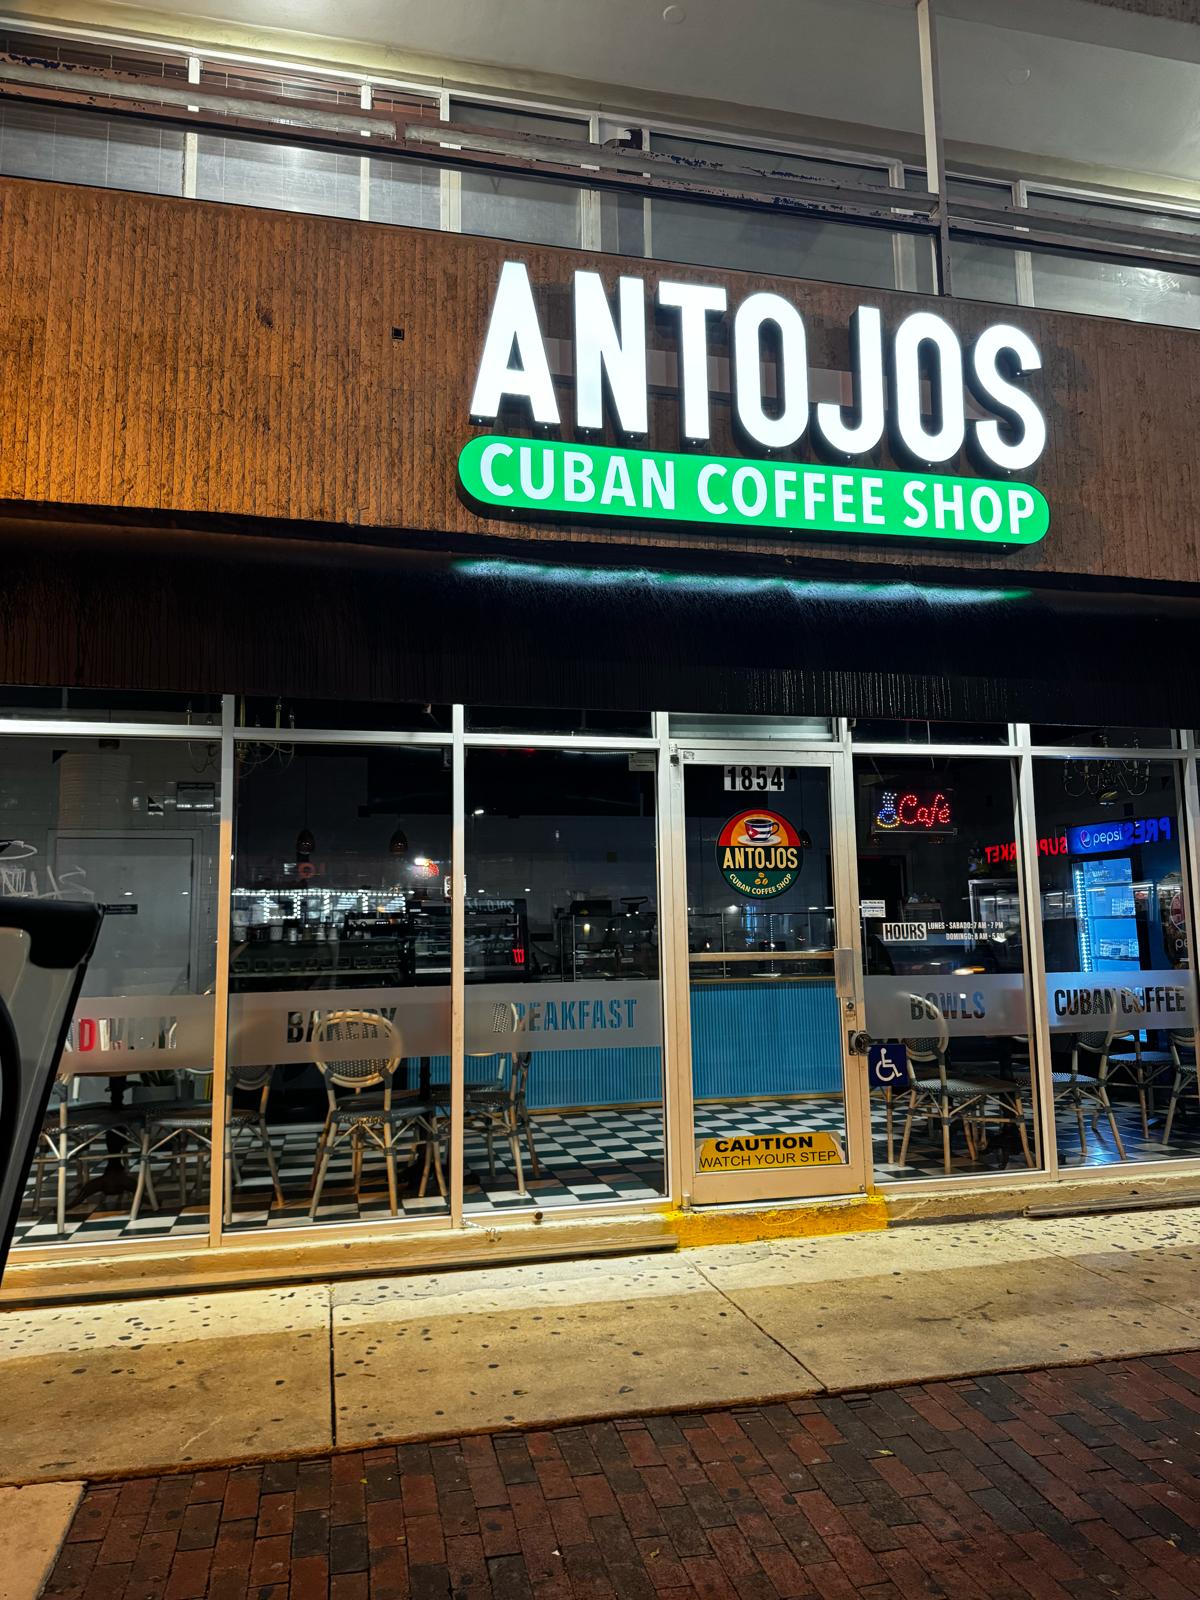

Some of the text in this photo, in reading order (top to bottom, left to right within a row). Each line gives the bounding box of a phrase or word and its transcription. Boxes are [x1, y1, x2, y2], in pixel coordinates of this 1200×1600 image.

[469, 260, 1047, 470] ANTOJOS
[479, 442, 1036, 535] CUBAN COFFEE SHOP
[727, 766, 784, 791] 1854
[899, 793, 951, 828] Café
[1092, 829, 1123, 846] pepsi
[722, 847, 798, 869] ANTOJOS
[729, 873, 792, 895] CUBAN COFFEE SHOP
[884, 923, 927, 941] HOURS
[927, 922, 945, 930] LUNES
[909, 990, 986, 1021] BOWLS
[1054, 985, 1187, 1017] CUBAN COFFEE
[492, 999, 637, 1033] BREAKFAST
[714, 1135, 814, 1153] CAUTION
[700, 1150, 837, 1169] WATCH YOUR STEP
